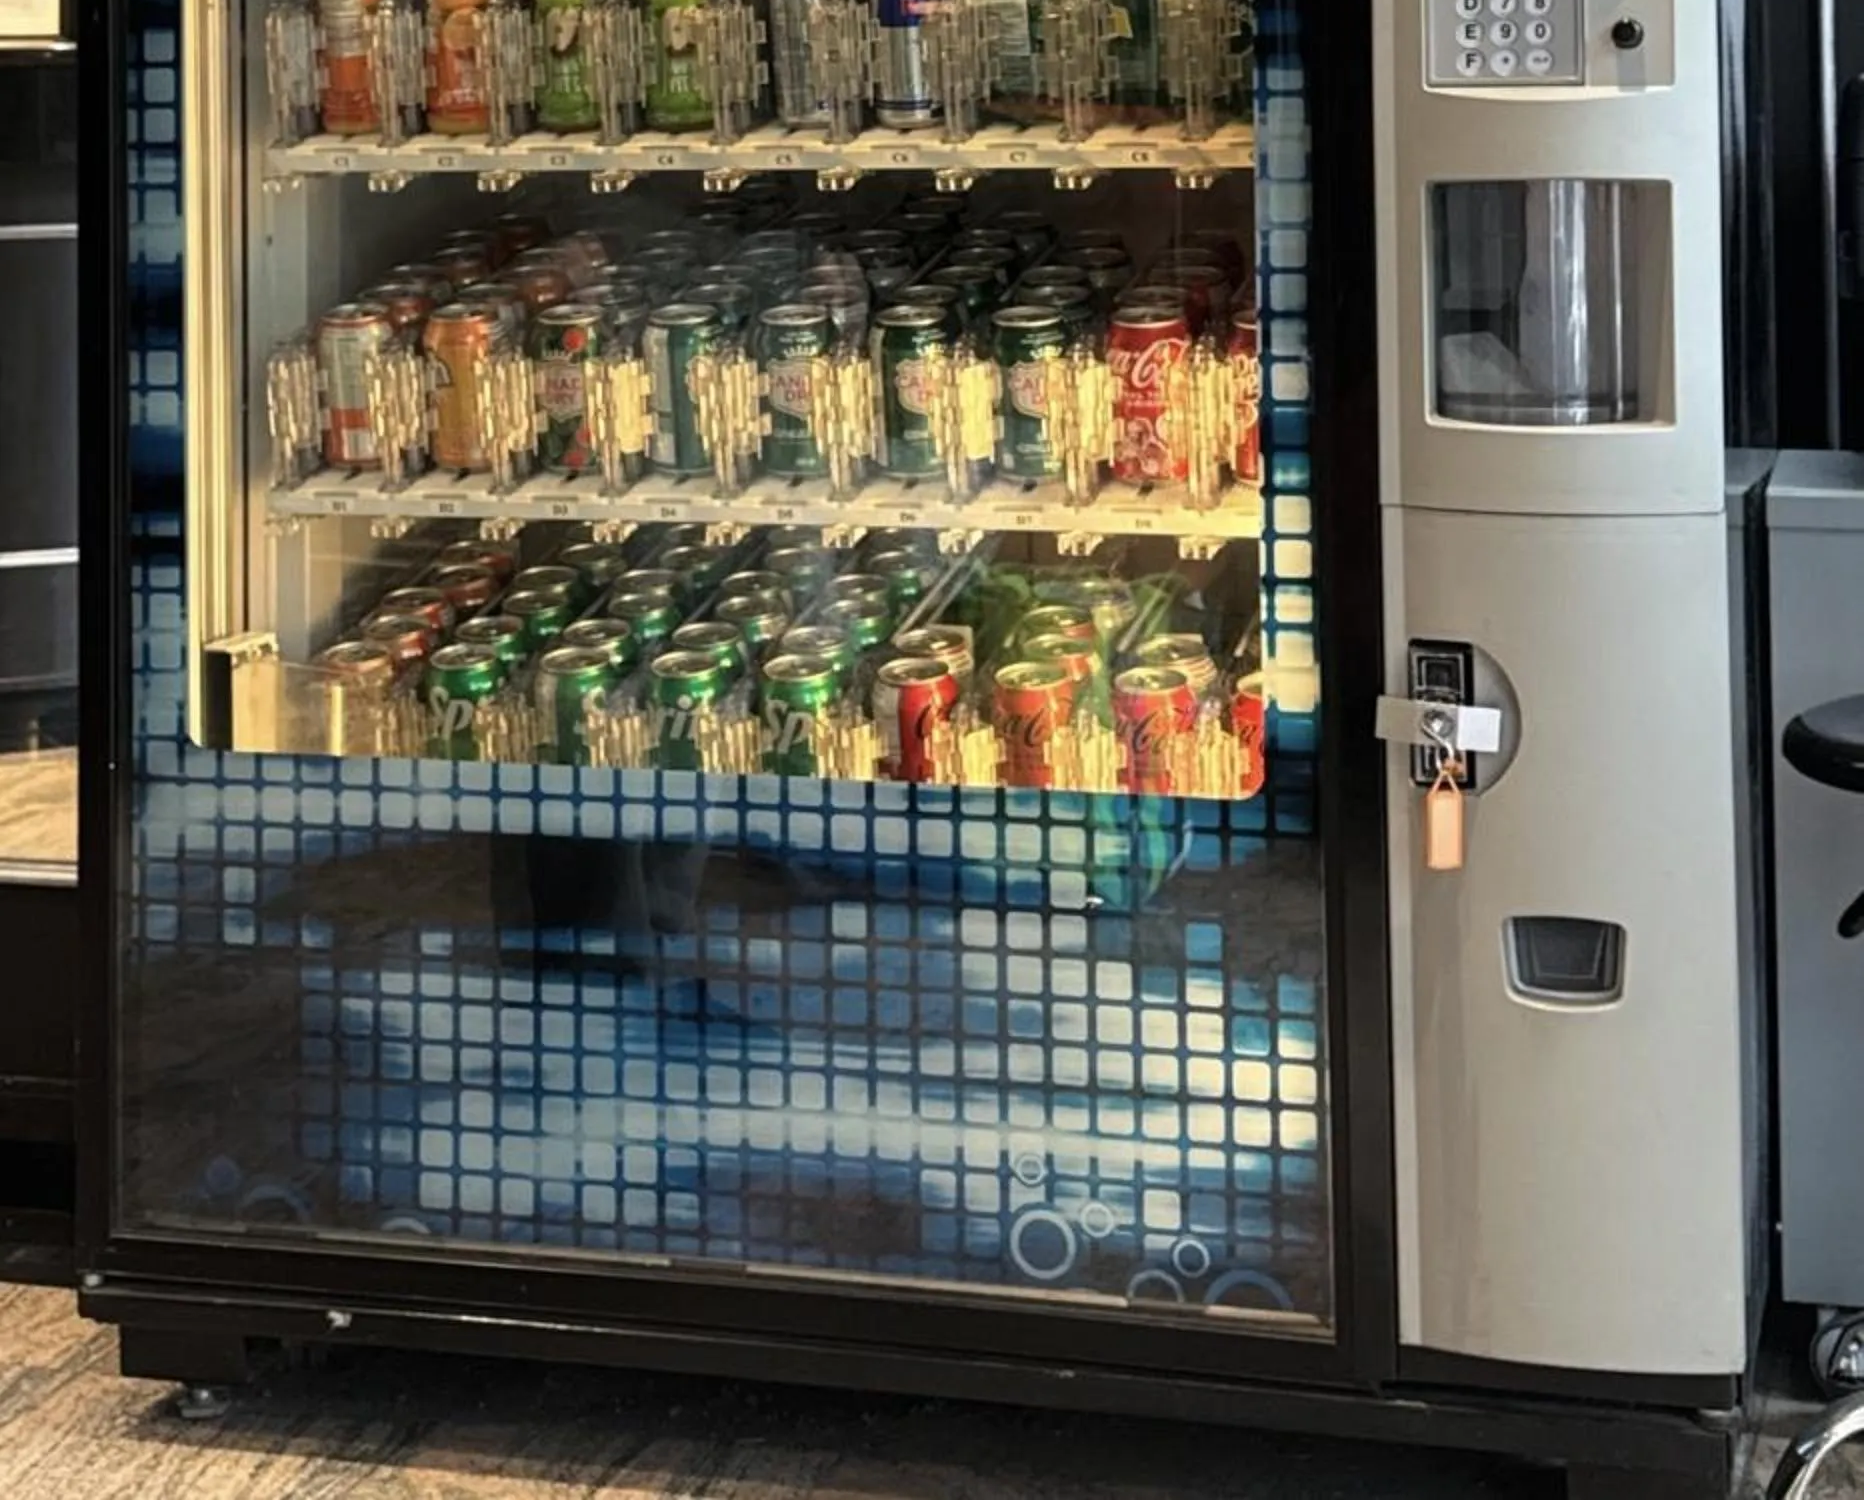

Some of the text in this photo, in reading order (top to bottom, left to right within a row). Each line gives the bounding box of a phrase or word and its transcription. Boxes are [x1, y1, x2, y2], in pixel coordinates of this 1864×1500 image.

[1466, 24, 1546, 40] E 9 0
[1466, 53, 1478, 68] F
